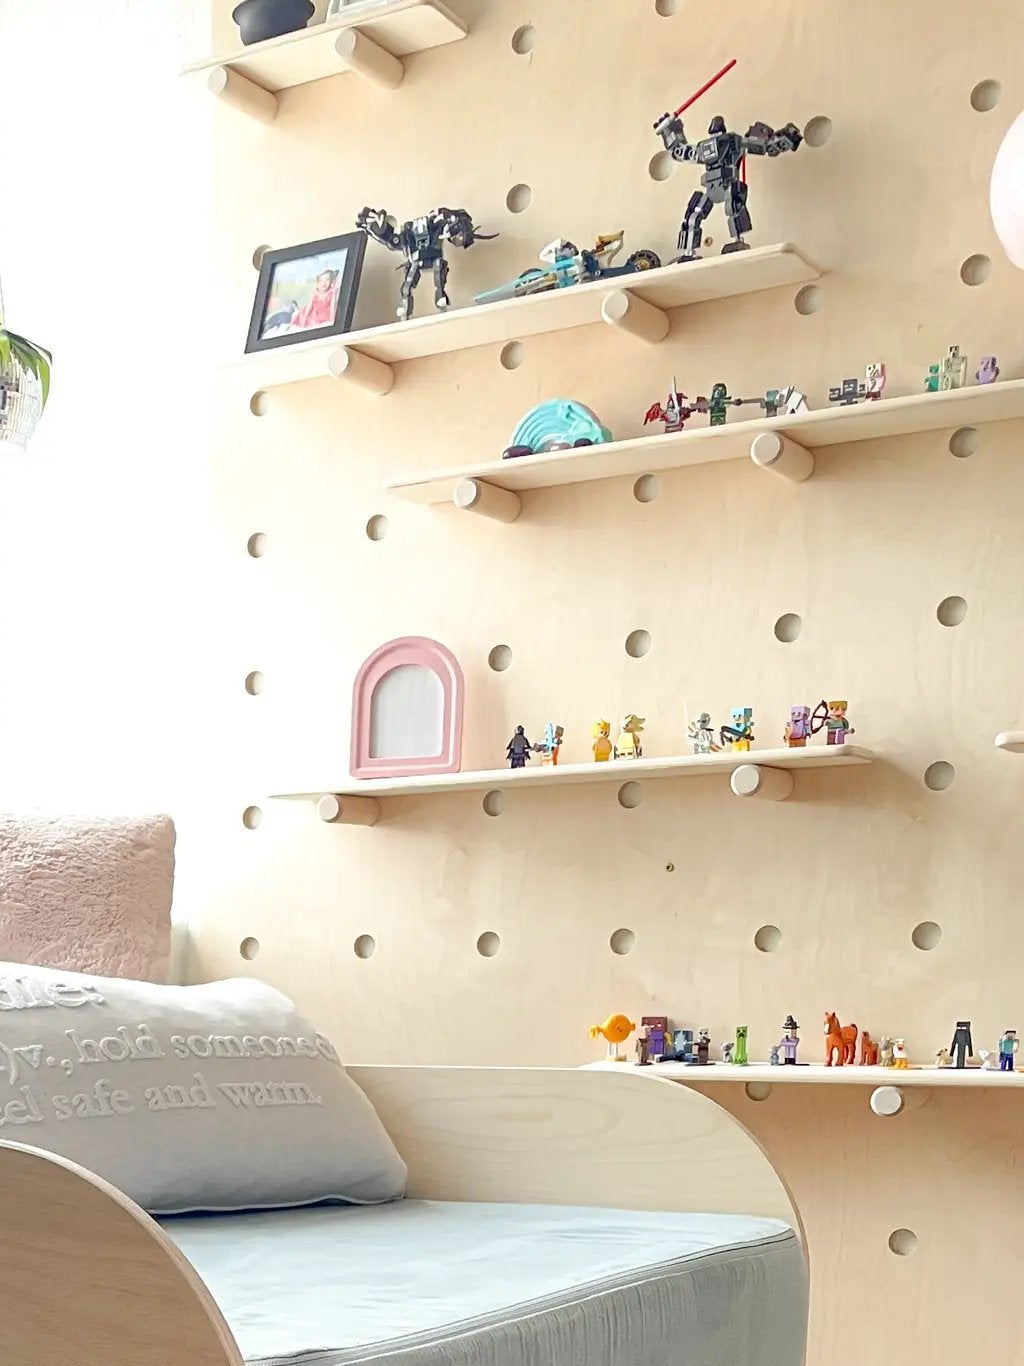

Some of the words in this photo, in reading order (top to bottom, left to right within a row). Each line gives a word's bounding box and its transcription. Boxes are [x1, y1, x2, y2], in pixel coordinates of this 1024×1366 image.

[64, 1024, 166, 1064] hold
[171, 1034, 319, 1060] someone
[51, 1078, 135, 1121] safe
[144, 1071, 218, 1110] and
